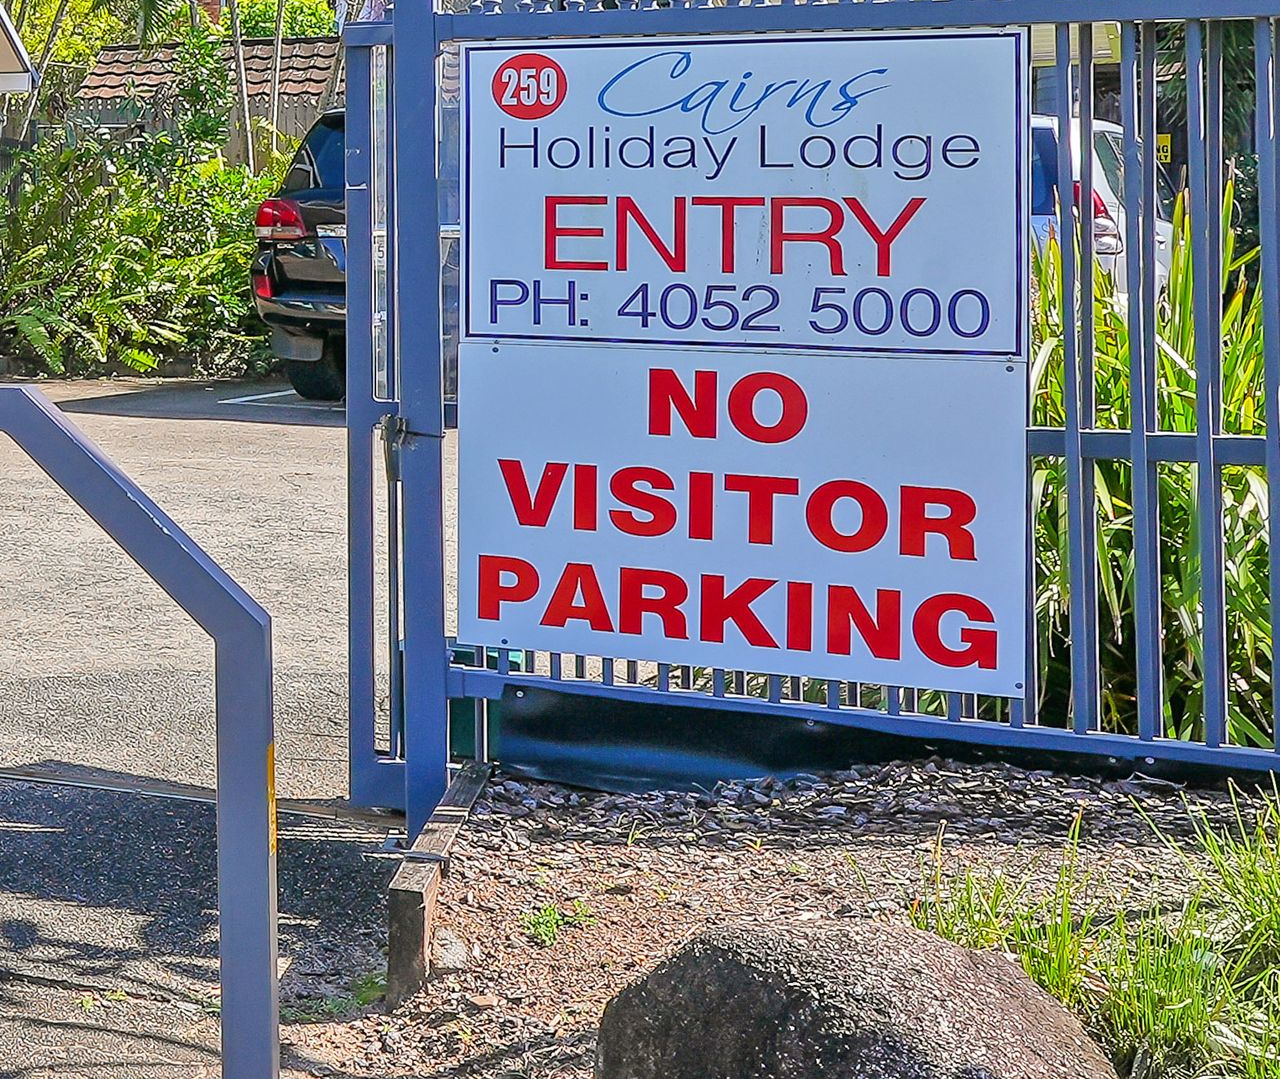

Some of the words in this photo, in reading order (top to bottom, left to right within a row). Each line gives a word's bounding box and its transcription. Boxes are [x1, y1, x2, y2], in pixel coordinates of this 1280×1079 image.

[500, 68, 561, 107] 259
[597, 51, 893, 136] Cairns
[499, 126, 738, 181] Holiday
[759, 123, 981, 181] Lodge
[545, 196, 924, 277] ENTRY
[489, 279, 590, 327] PH:
[617, 283, 781, 332] 4052
[808, 286, 990, 339] 5000
[649, 368, 808, 444] NO
[498, 458, 978, 561] VISITOR
[478, 554, 998, 670] PARKING
